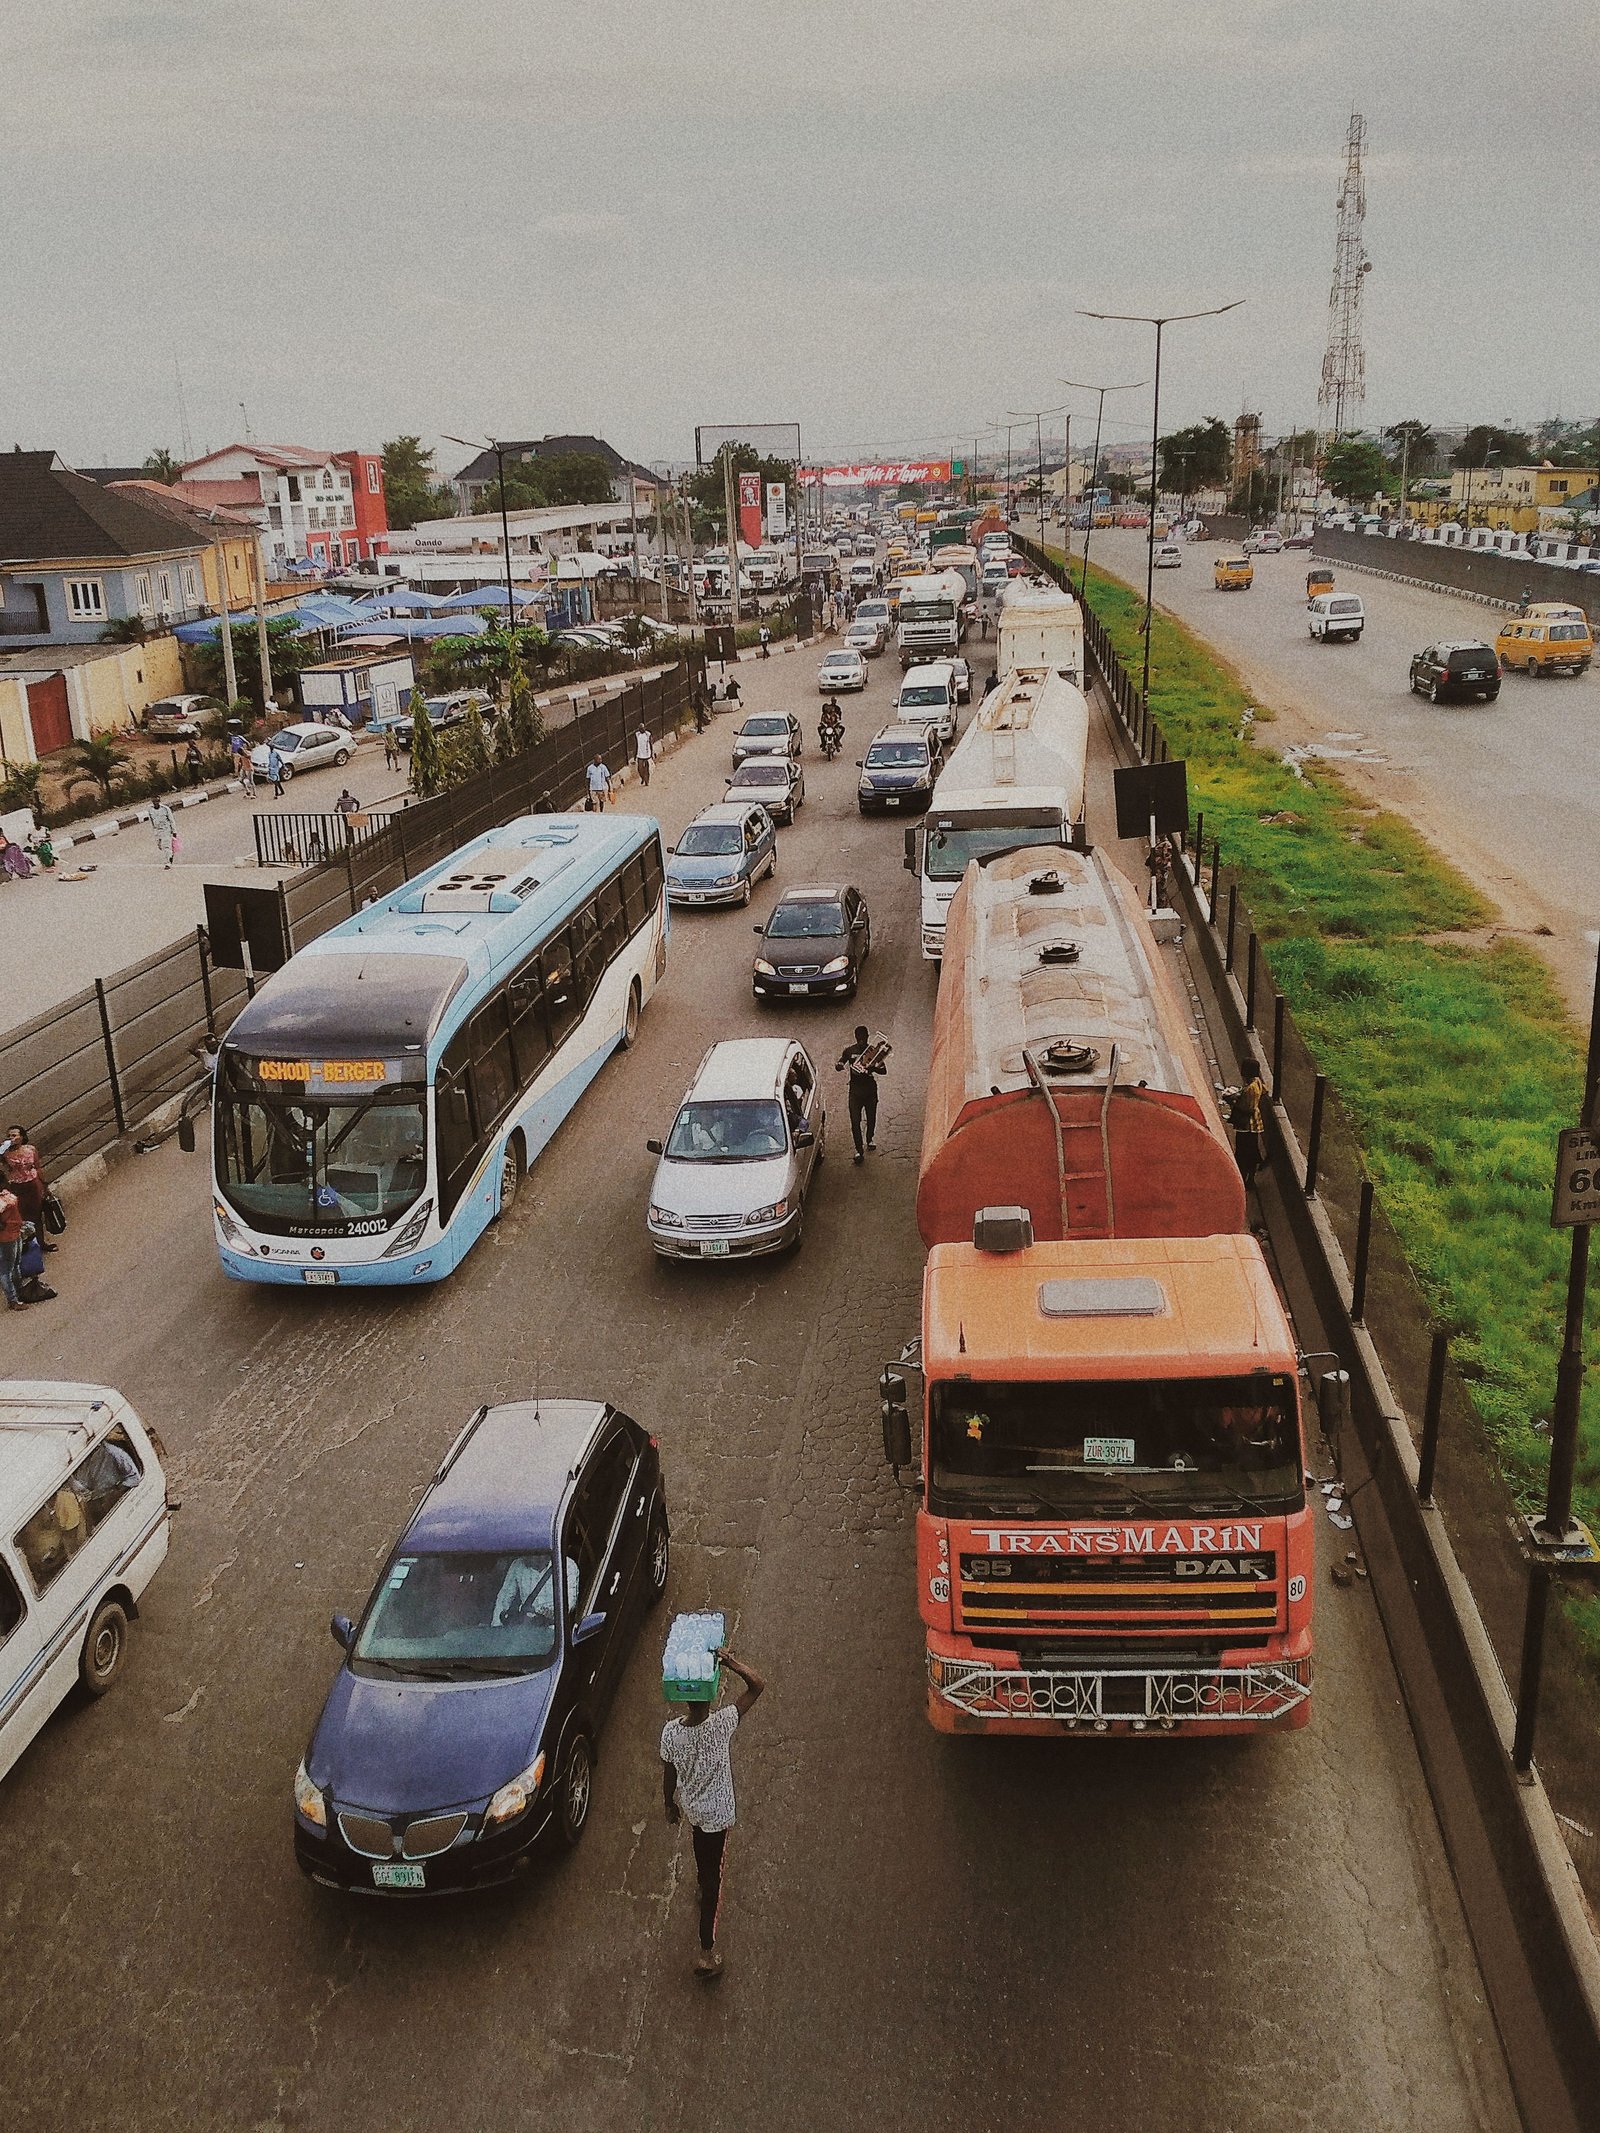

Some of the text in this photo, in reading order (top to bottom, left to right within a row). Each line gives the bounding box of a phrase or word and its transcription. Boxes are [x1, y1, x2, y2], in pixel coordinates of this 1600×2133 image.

[415, 539, 442, 547] Oando
[347, 1218, 388, 1236] 240012
[970, 1559, 1012, 1576] 95
[1175, 1559, 1266, 1576] DAF
[1290, 1580, 1303, 1596] 80
